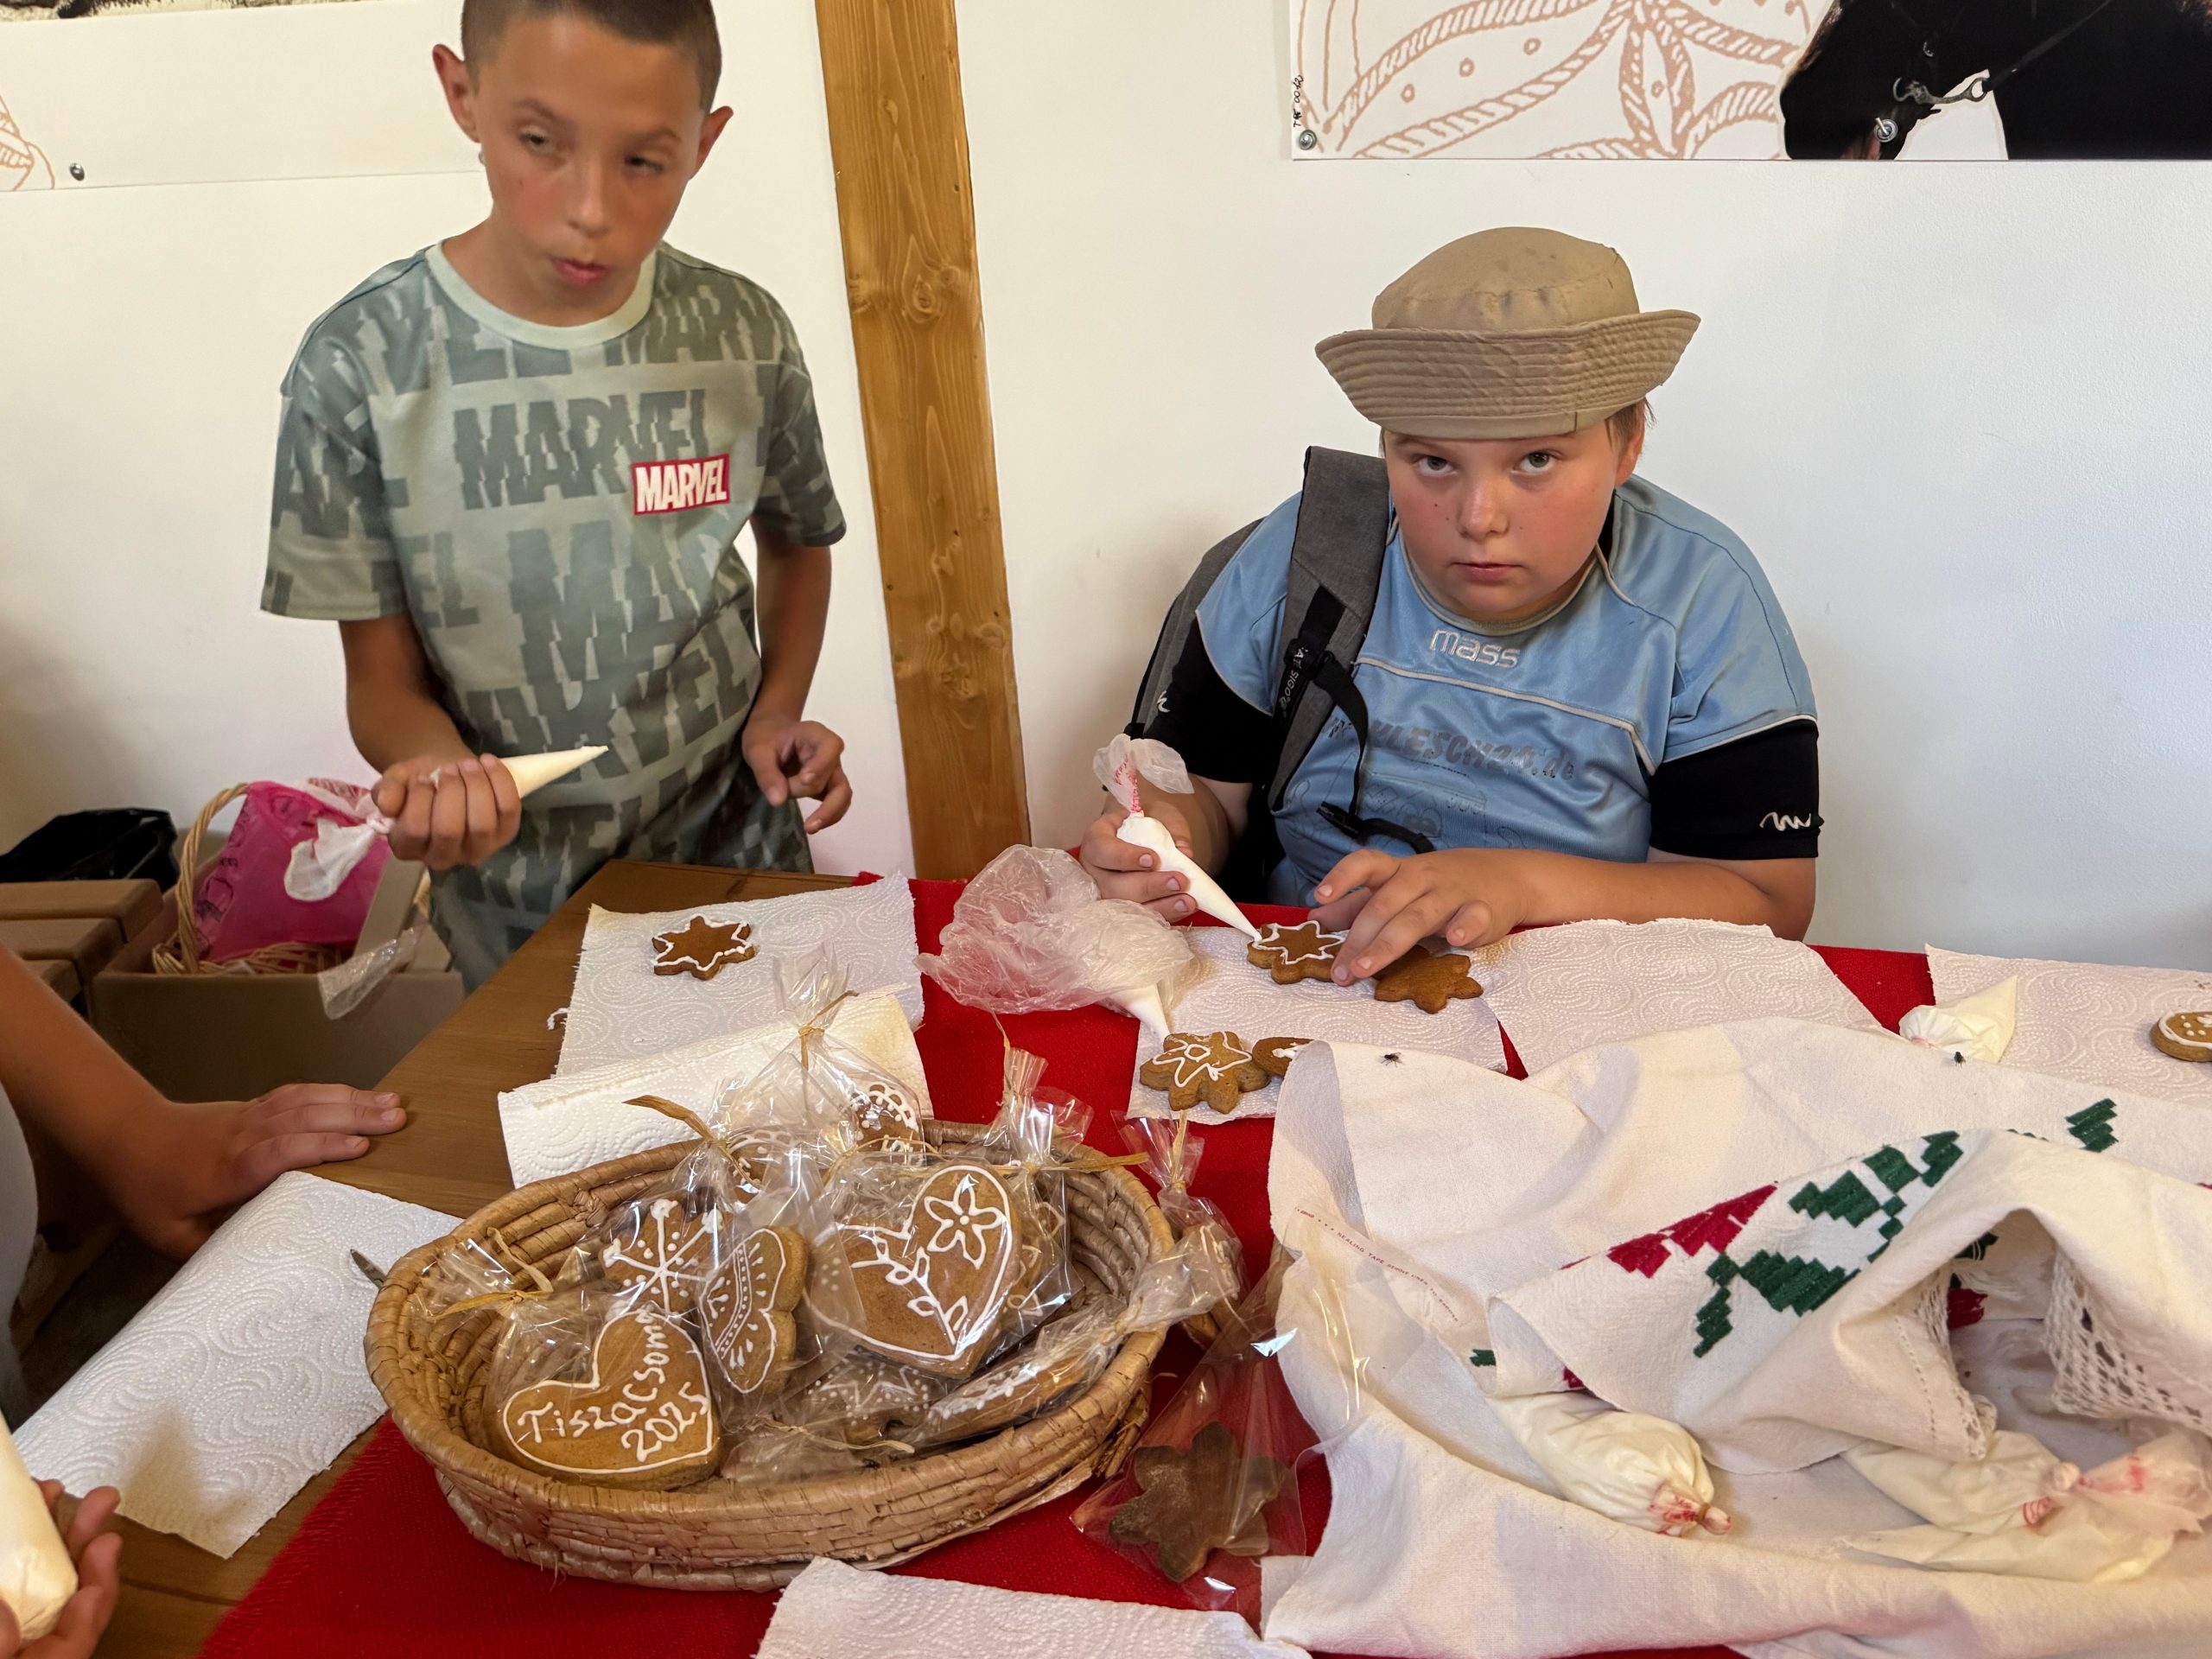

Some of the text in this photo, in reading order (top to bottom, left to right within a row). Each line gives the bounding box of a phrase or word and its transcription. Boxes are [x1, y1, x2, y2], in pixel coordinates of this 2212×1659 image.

[635, 459, 727, 512] MARVEL
[1430, 630, 1520, 668] mass
[1337, 1232, 1364, 1253] SEALING
[1368, 1252, 1385, 1264] TAPE
